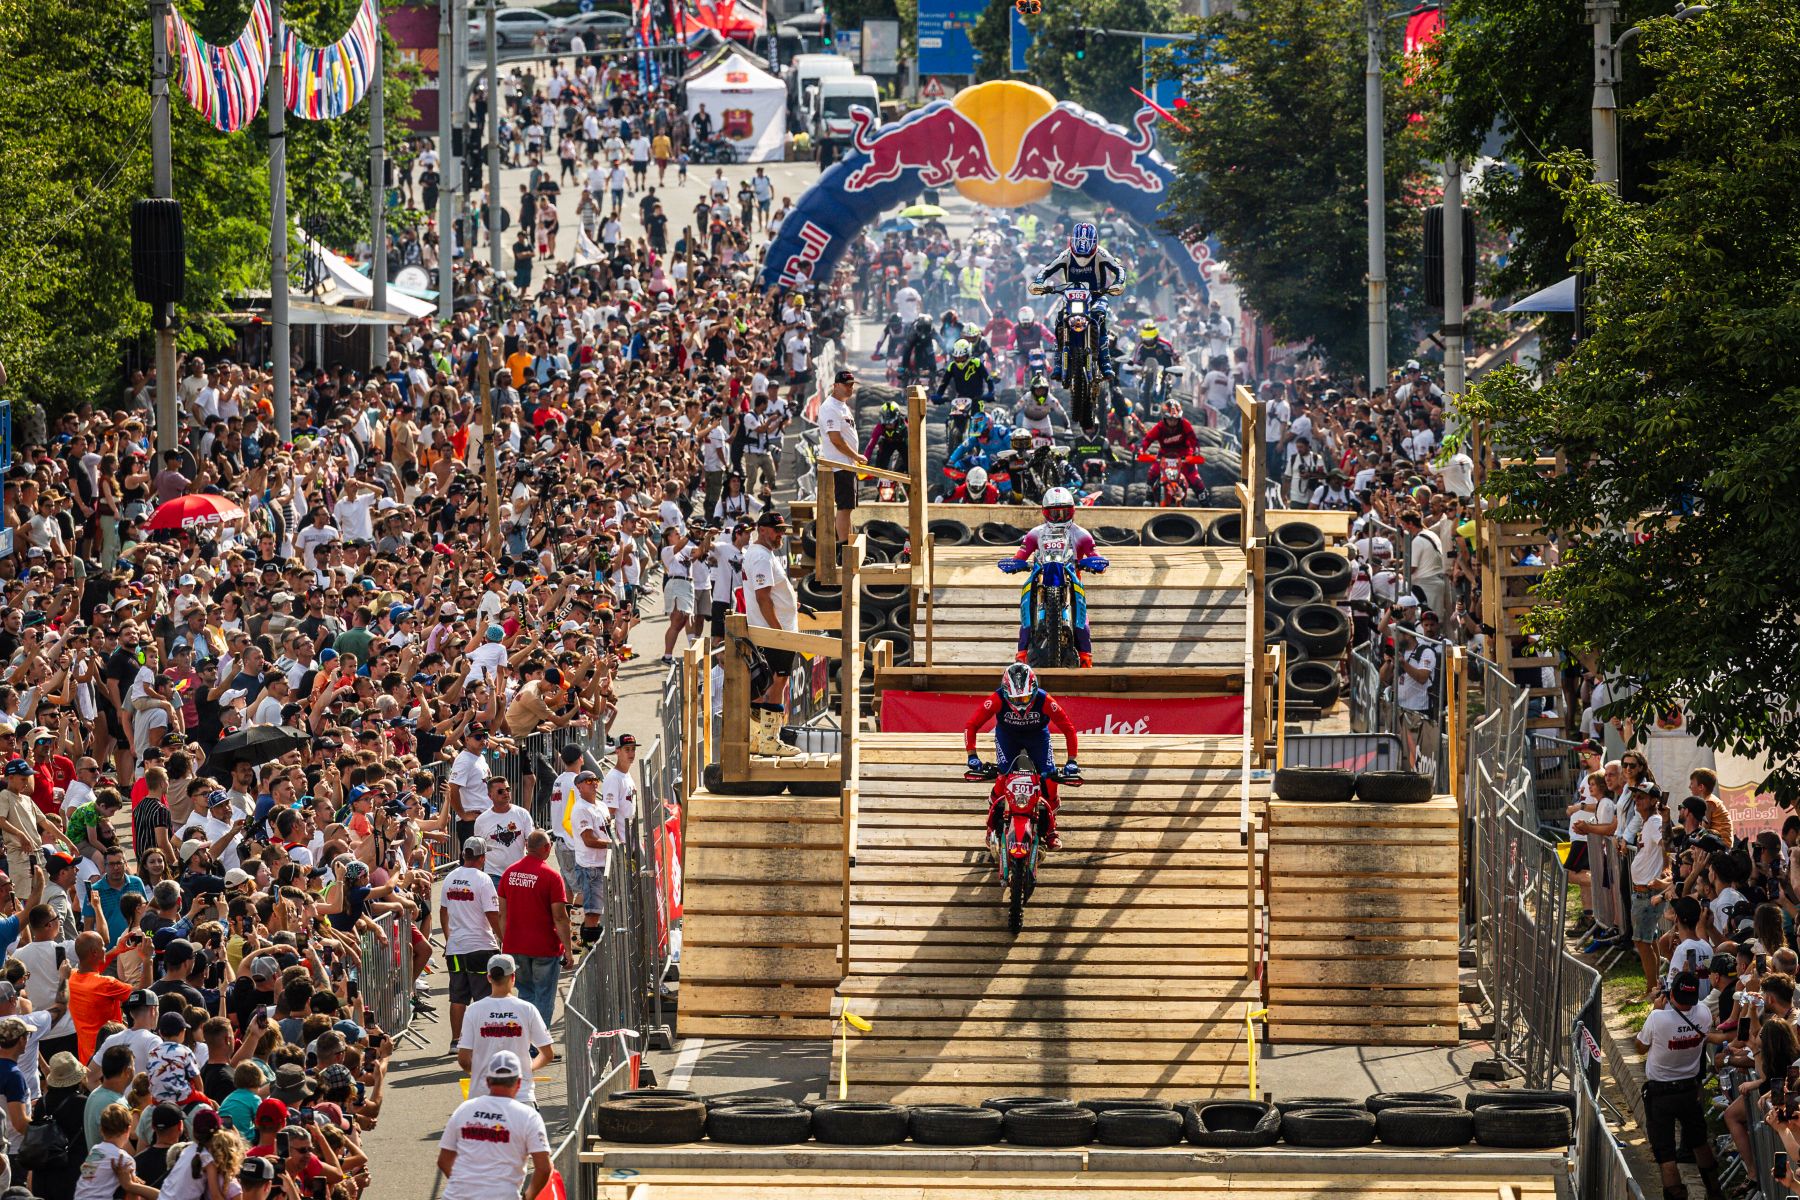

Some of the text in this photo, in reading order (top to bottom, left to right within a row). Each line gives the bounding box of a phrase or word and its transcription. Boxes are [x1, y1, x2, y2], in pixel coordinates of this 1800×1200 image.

[1014, 785, 1030, 794] 301
[508, 877, 536, 889] SECURITY
[473, 1111, 503, 1121] STAFF
